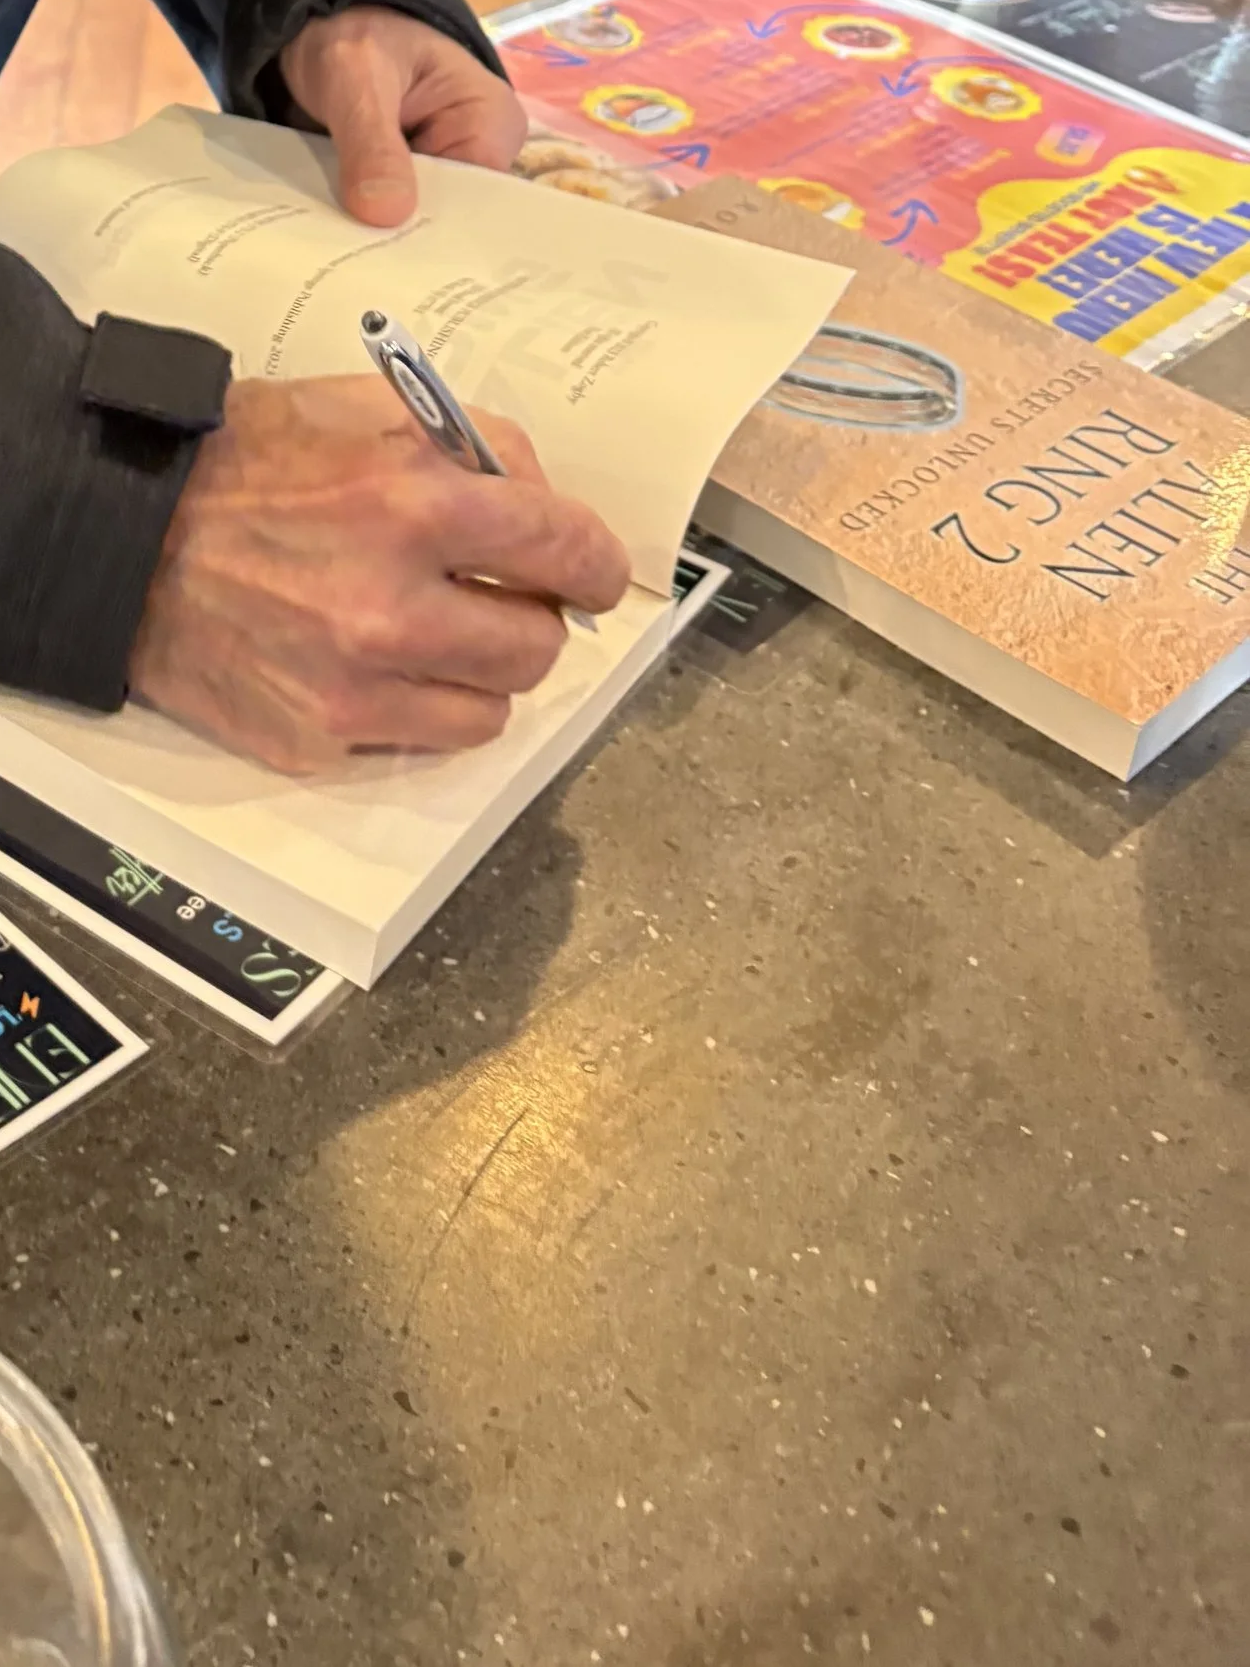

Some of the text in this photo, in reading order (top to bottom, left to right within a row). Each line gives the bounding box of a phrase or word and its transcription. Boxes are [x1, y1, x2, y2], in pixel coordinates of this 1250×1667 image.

[1068, 181, 1155, 233] HOT
[1135, 202, 1201, 243] IS
[1153, 212, 1250, 281] NEW
[270, 288, 312, 344] Publishing
[1051, 265, 1180, 343] MENU
[835, 360, 1102, 537] SECRETS UNLOCKED
[928, 408, 1178, 577] RING 2
[1038, 458, 1227, 605] ALIEN
